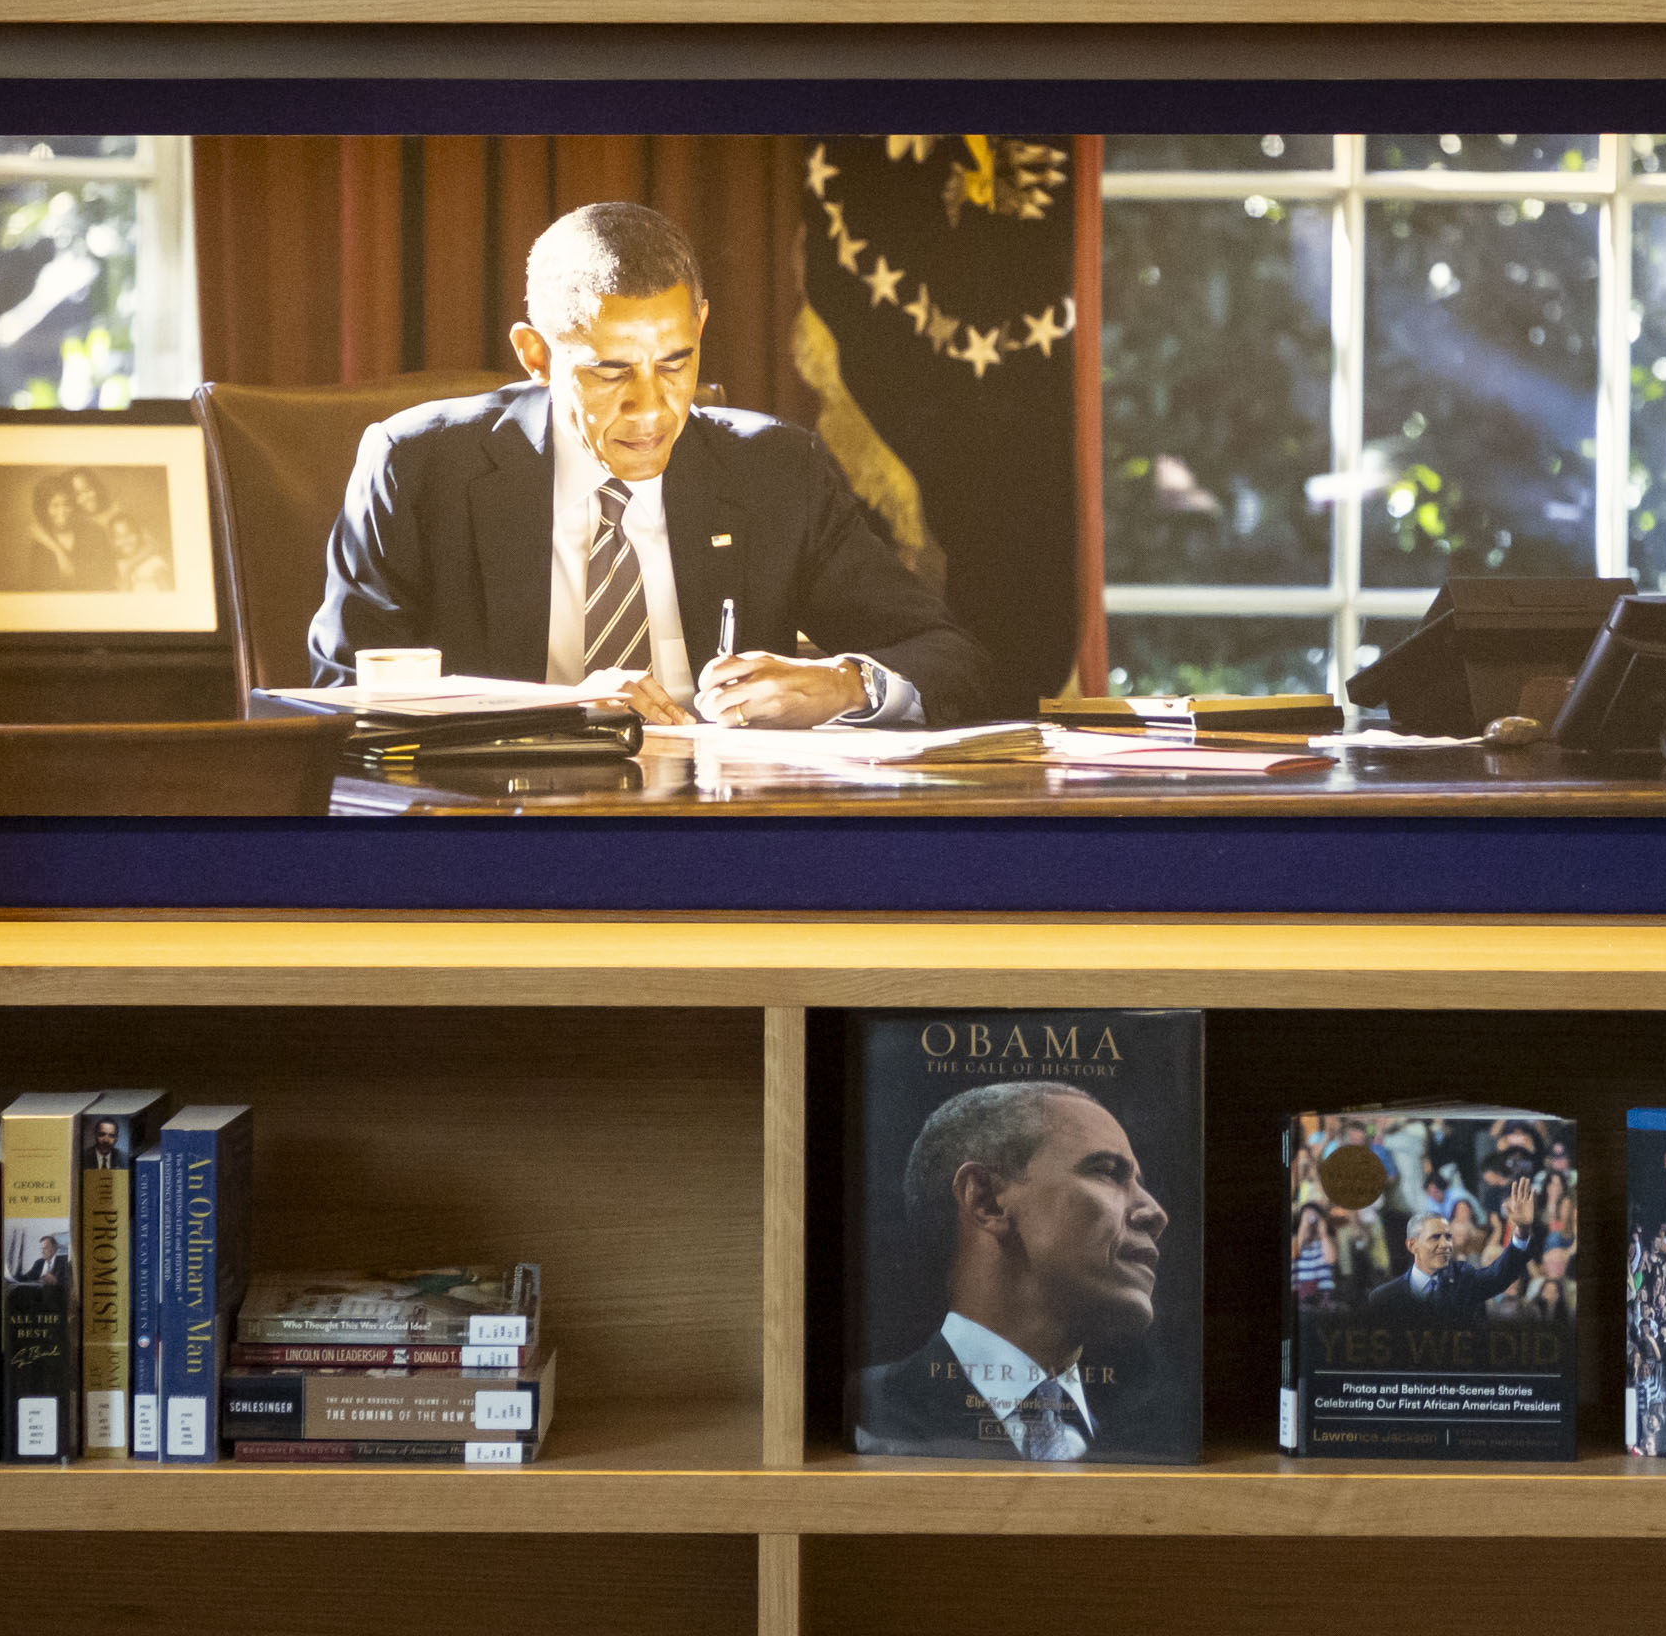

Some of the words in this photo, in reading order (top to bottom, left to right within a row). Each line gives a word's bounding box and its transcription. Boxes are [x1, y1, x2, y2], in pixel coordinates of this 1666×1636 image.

[921, 1023, 1123, 1061] OBAMA
[229, 1400, 293, 1414] SCHLESINGER
[1314, 1397, 1373, 1411] Celebrating
[1376, 1398, 1397, 1411] Our
[1400, 1399, 1420, 1411] First
[1423, 1399, 1460, 1412] African
[1463, 1400, 1512, 1412] American
[1514, 1400, 1560, 1413] President
